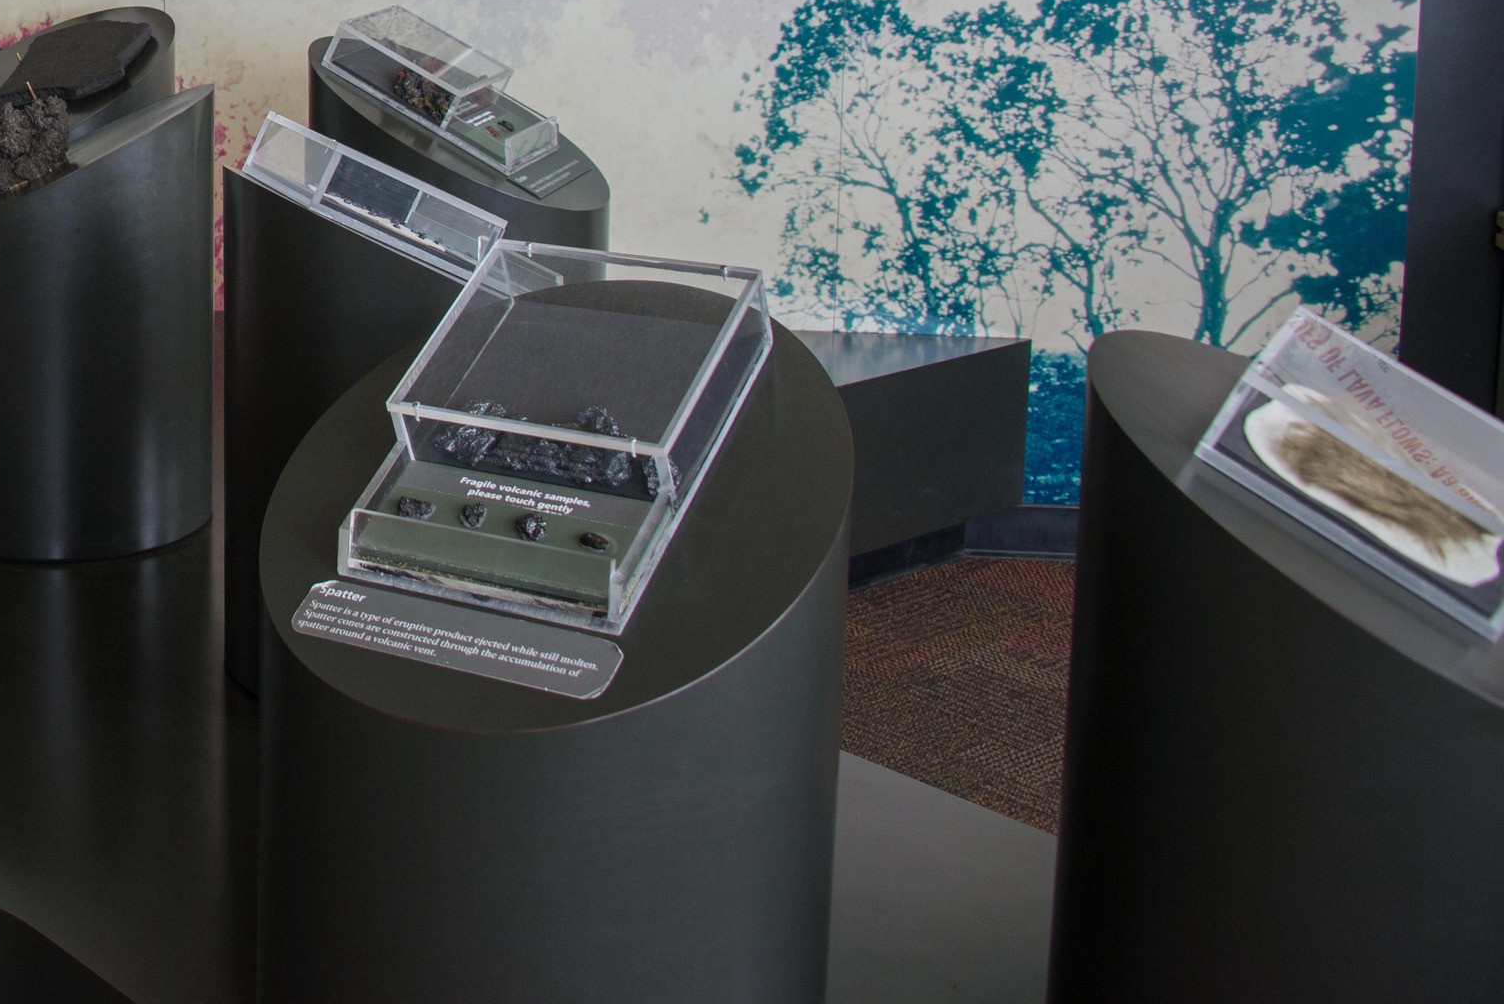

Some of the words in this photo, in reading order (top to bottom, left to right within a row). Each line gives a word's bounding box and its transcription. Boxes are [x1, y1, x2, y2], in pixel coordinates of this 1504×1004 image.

[460, 476, 496, 489] Fragile
[499, 484, 543, 498] volcanic
[544, 492, 591, 508] samples,
[467, 488, 502, 500] please
[504, 495, 535, 507] touch
[537, 502, 573, 514] gently
[319, 584, 366, 602] Spatter
[297, 619, 329, 632] spatter
[330, 626, 365, 640] around
[373, 636, 412, 651] volcanic
[414, 646, 436, 656] vent.
[303, 609, 337, 622] Spatter
[338, 617, 364, 629] cones
[365, 624, 381, 632] are
[382, 627, 440, 646] constructed
[440, 640, 479, 655] through
[481, 648, 497, 659] the
[498, 654, 566, 675] accumulation
[568, 669, 582, 678] of
[310, 599, 343, 612] Spatter
[344, 607, 351, 615] is
[360, 612, 381, 622] type
[382, 616, 394, 624] of
[394, 619, 433, 634] eruptive
[432, 628, 473, 642] product
[474, 637, 510, 651] ejected
[512, 644, 538, 657] while
[540, 652, 559, 662] still
[560, 655, 599, 671] molten.
